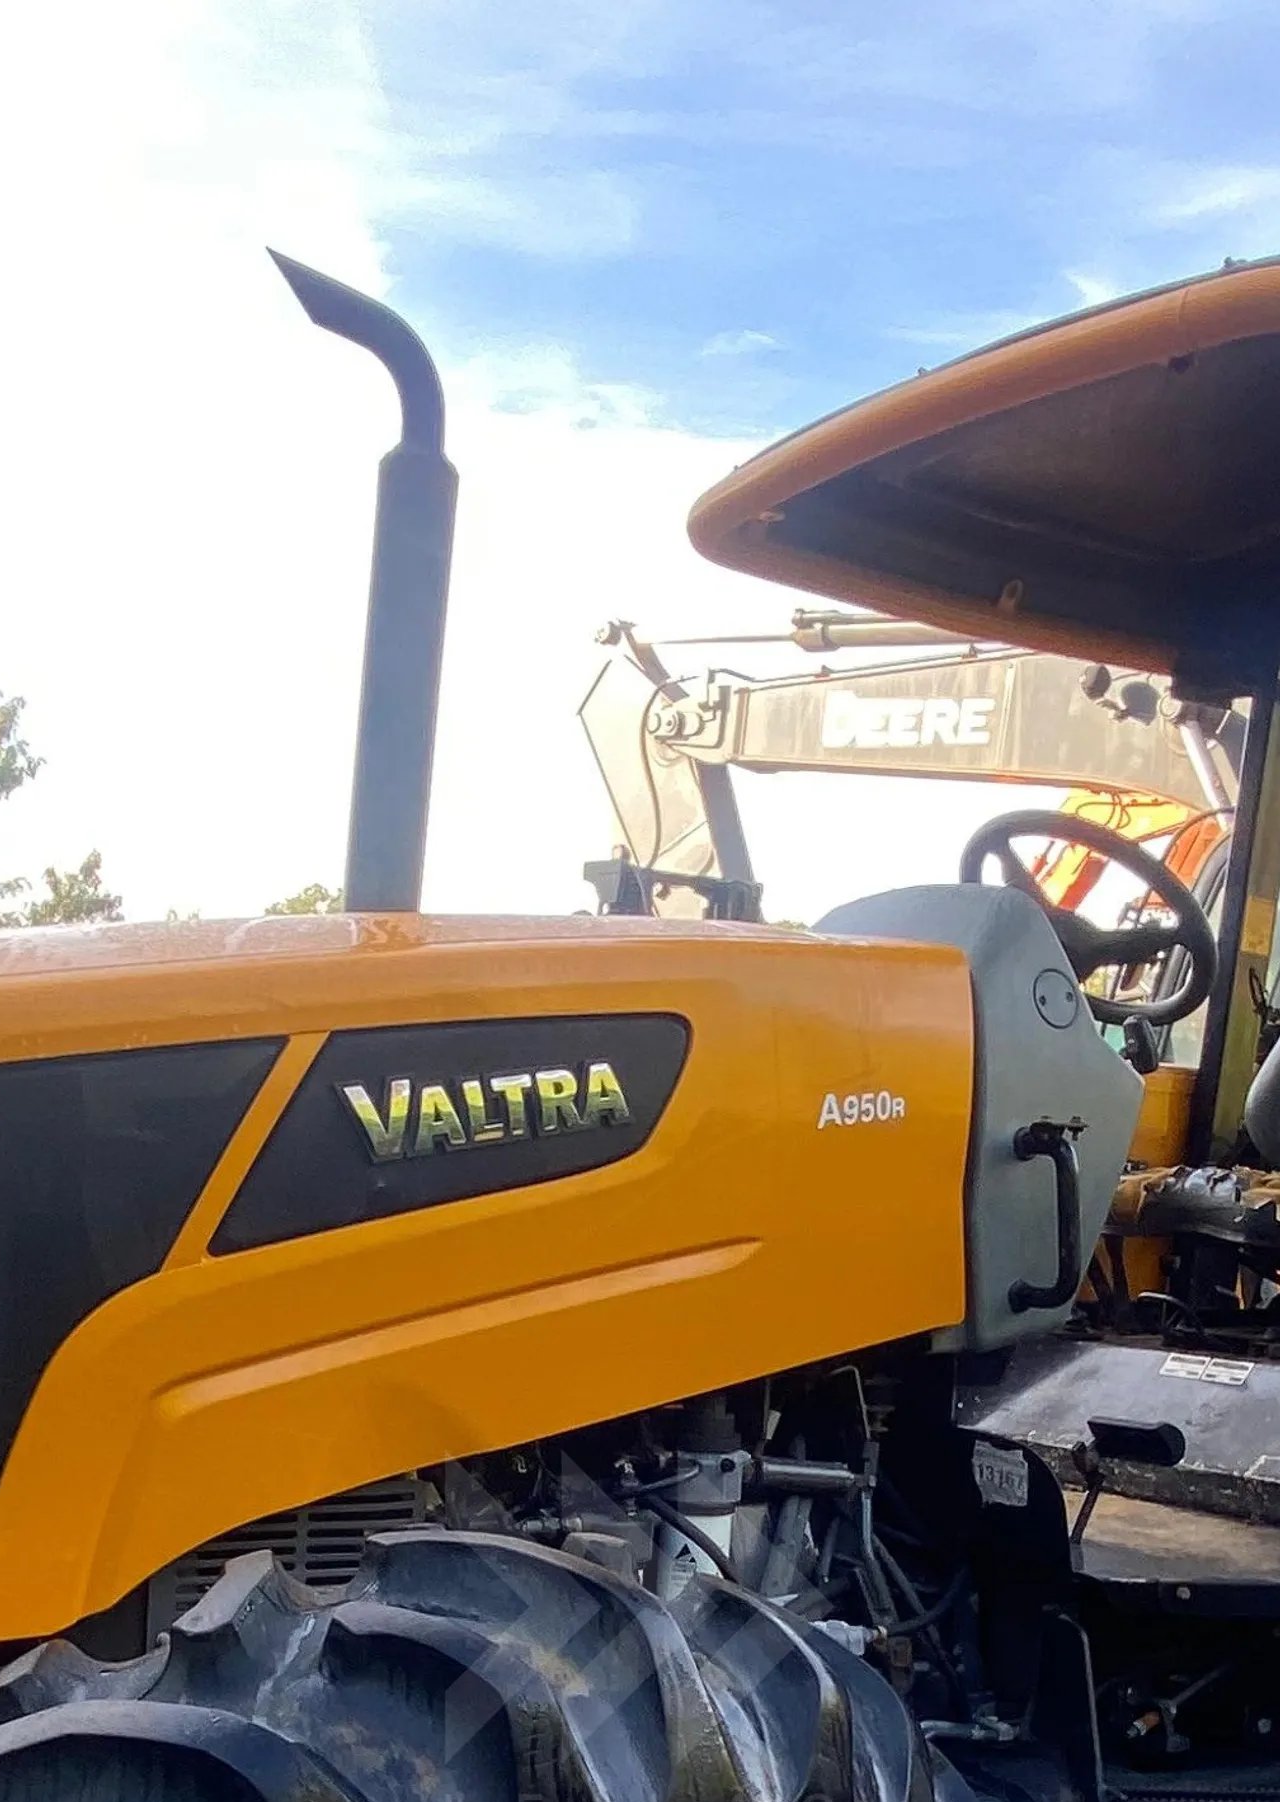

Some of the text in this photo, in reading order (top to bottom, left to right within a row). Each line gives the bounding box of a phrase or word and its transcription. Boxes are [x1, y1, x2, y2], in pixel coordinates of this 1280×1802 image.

[821, 689, 996, 749] DEERE
[339, 1060, 632, 1161] VALTRA
[817, 1090, 905, 1130] A950R
